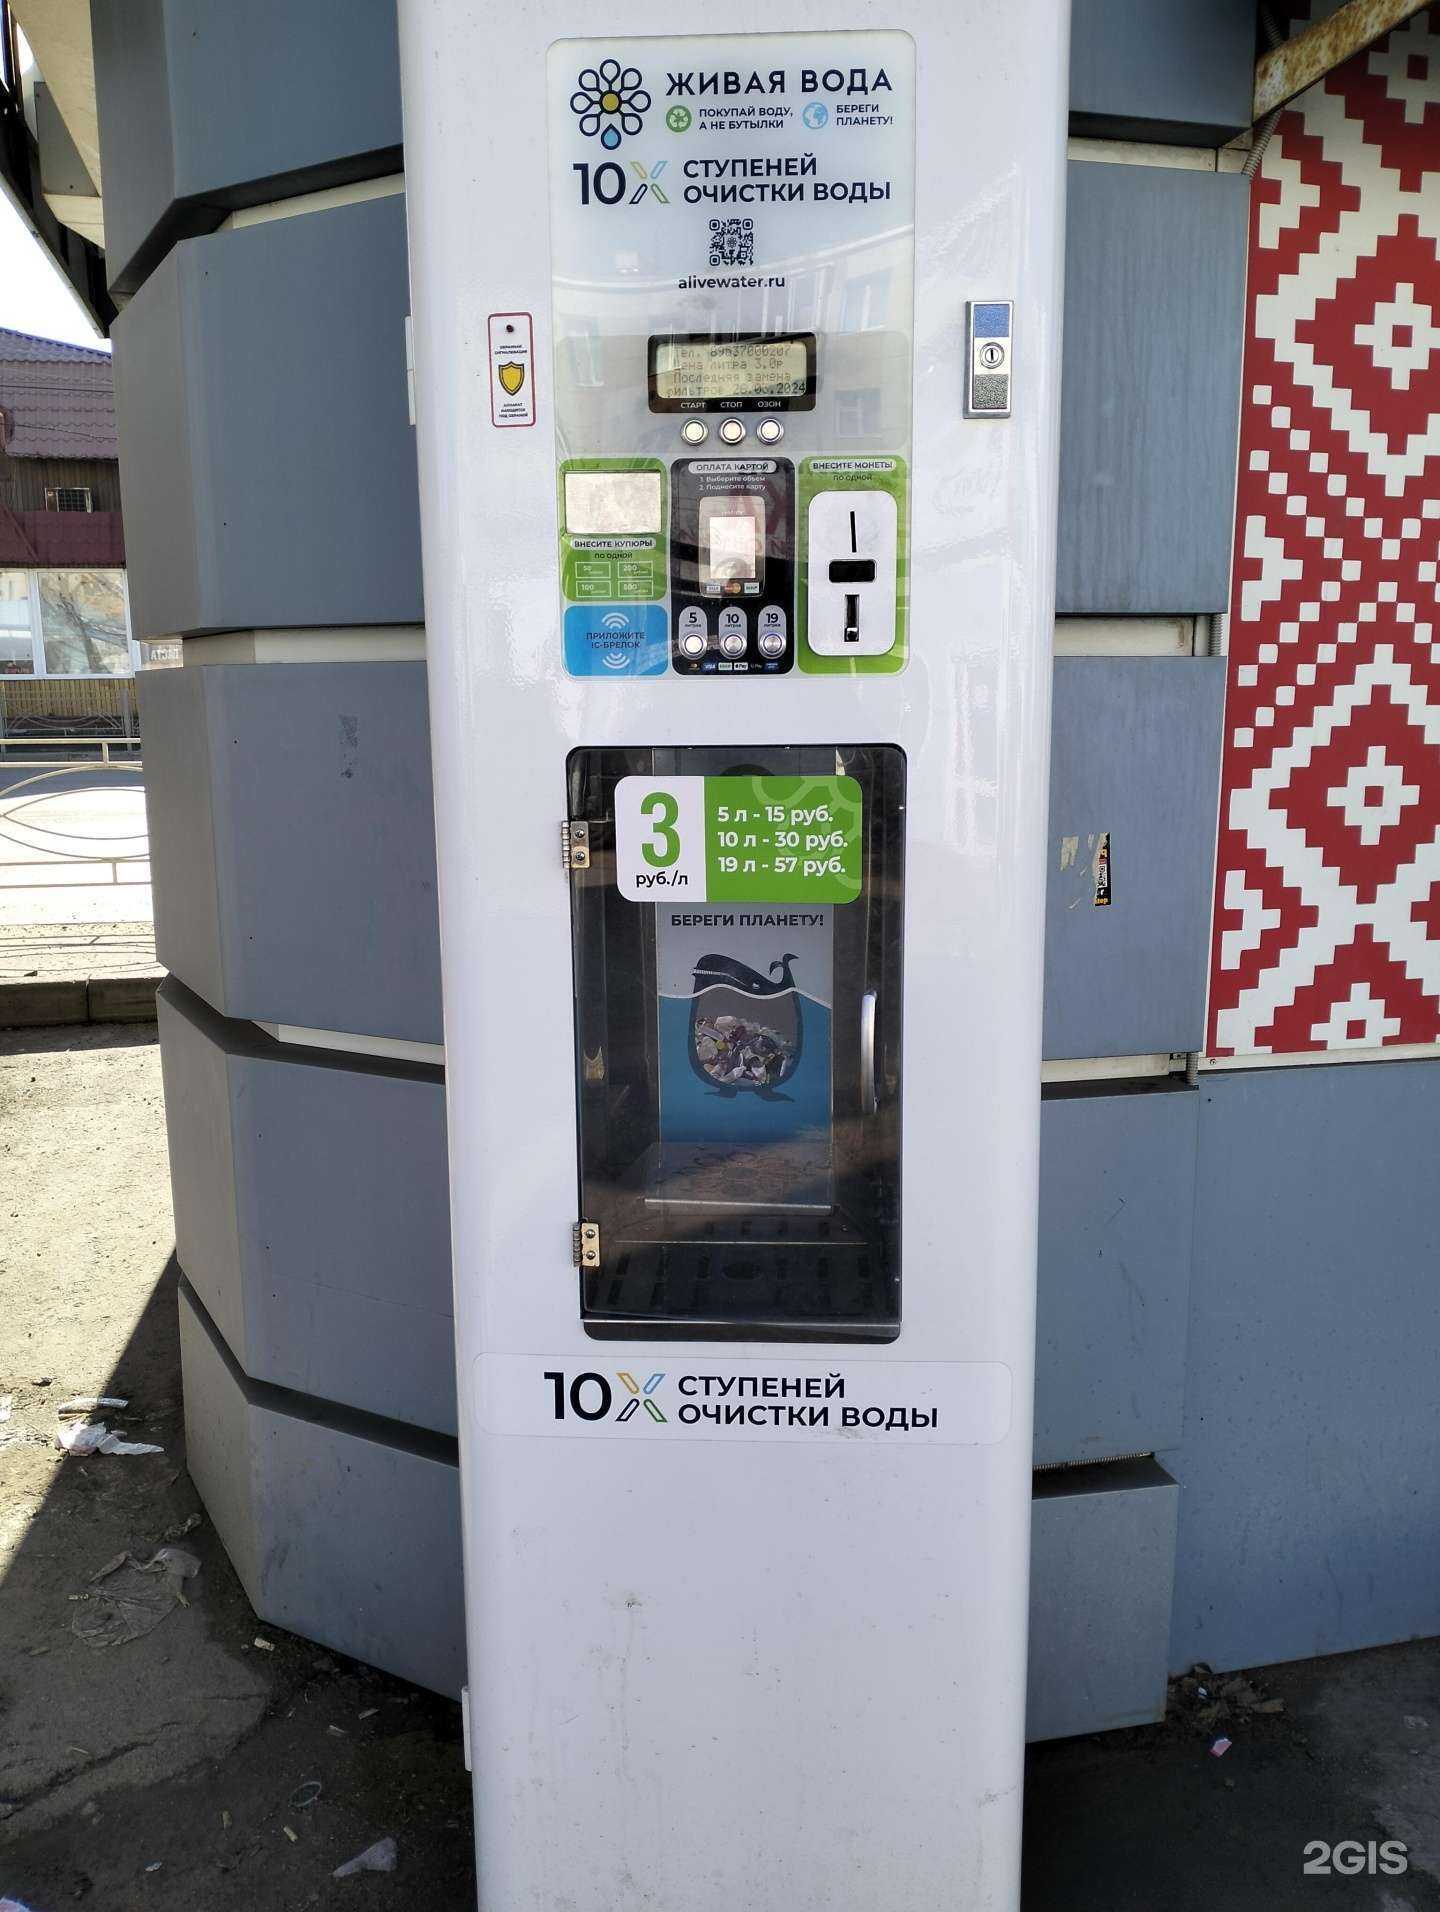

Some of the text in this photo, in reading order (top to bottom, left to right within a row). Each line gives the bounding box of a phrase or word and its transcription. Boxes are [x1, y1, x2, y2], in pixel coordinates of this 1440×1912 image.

[665, 68, 893, 96] ЖИВАЯ ВОДА
[699, 105, 793, 118] ПОКУПАЙ ВОДУ,
[836, 103, 880, 114] БЕРЕГИ
[699, 119, 784, 130] А НЕ БУТЫЛКИ
[836, 115, 894, 126] ПЛАНЕТУ!
[683, 153, 817, 178] СТУПЕНЕЙ
[683, 181, 891, 204] ОЧИСТКИ ВОДЫ
[678, 275, 786, 290] alivewater.ru
[735, 463, 769, 471] КАРТОЙ
[574, 540, 612, 548] ВНЕСИТЕ
[688, 612, 698, 624] 5
[726, 613, 740, 624] 10
[766, 613, 778, 623] 19
[586, 632, 646, 640] ПРИЛОЖИТЕ
[717, 807, 729, 822] 5
[734, 810, 747, 822] л
[765, 807, 785, 822] 15
[791, 805, 833, 825] руб.
[640, 791, 681, 868] 3
[717, 832, 739, 847] 10
[743, 835, 757, 847] л
[774, 831, 800, 847] 30
[805, 830, 848, 850] руб.
[718, 857, 738, 872] 19
[743, 860, 756, 872] л
[774, 857, 798, 872] 57
[803, 856, 846, 876] руб.
[635, 870, 688, 888] руб./л
[671, 914, 824, 926] БЕРЕГИ ПЛАНЕТУ!
[678, 1373, 845, 1398] СТУПЕНЕЙ
[678, 1404, 938, 1431] ОЧИСТКИ ВОДЫ
